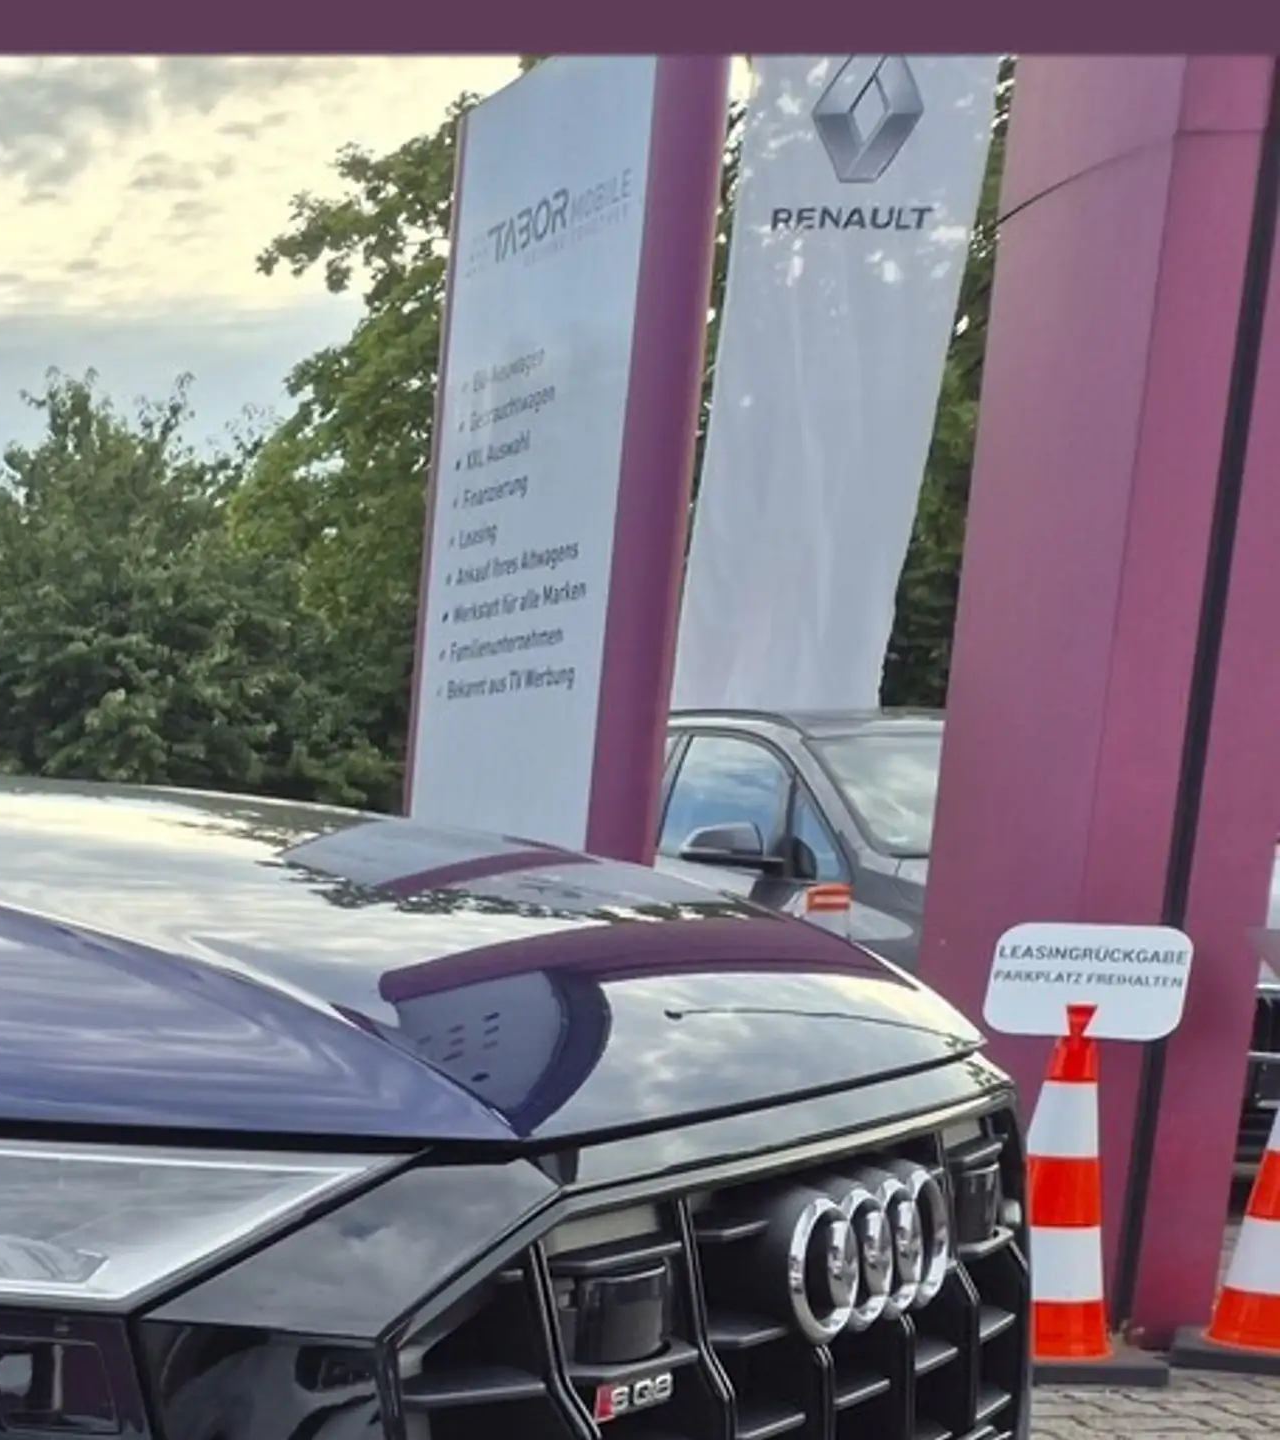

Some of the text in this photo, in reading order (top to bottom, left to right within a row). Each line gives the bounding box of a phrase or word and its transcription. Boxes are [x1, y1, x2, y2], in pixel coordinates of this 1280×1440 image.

[771, 205, 934, 231] RENAULT
[461, 475, 528, 508] Finanzierung
[459, 524, 497, 549] Leasing
[456, 559, 490, 585] Ankauf
[543, 580, 587, 605] Marken
[447, 666, 575, 700] Bekannt aus TV Werbung
[998, 945, 1188, 966] LEASINGRÜCKGABE
[993, 969, 1183, 989] PARKPLATZ FREIHALTEN
